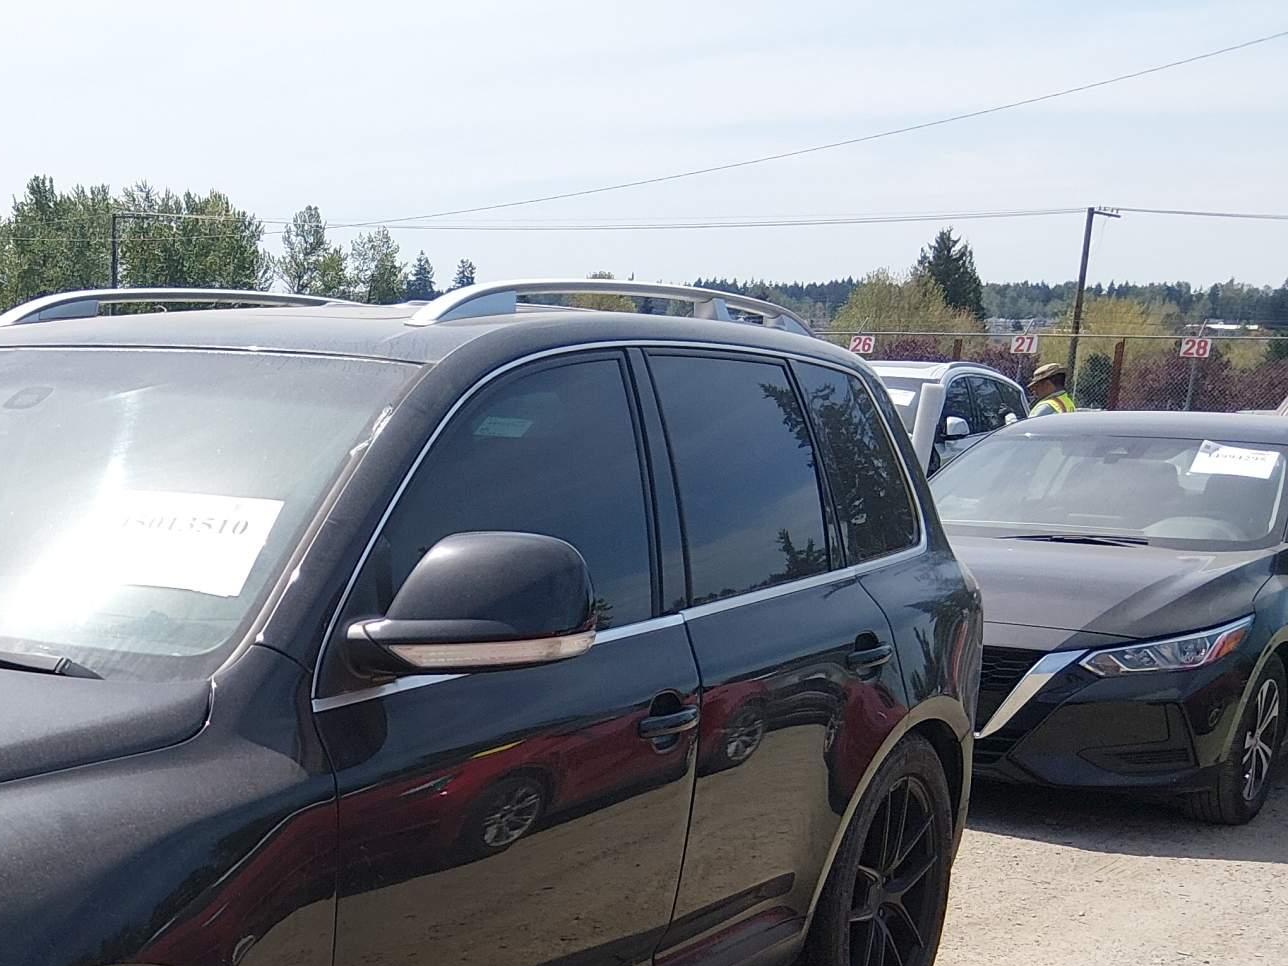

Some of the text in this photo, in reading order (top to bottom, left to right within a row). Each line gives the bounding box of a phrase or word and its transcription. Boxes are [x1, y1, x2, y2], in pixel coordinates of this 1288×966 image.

[851, 336, 873, 353] 26
[1014, 336, 1034, 353] 27
[1183, 339, 1209, 357] 28
